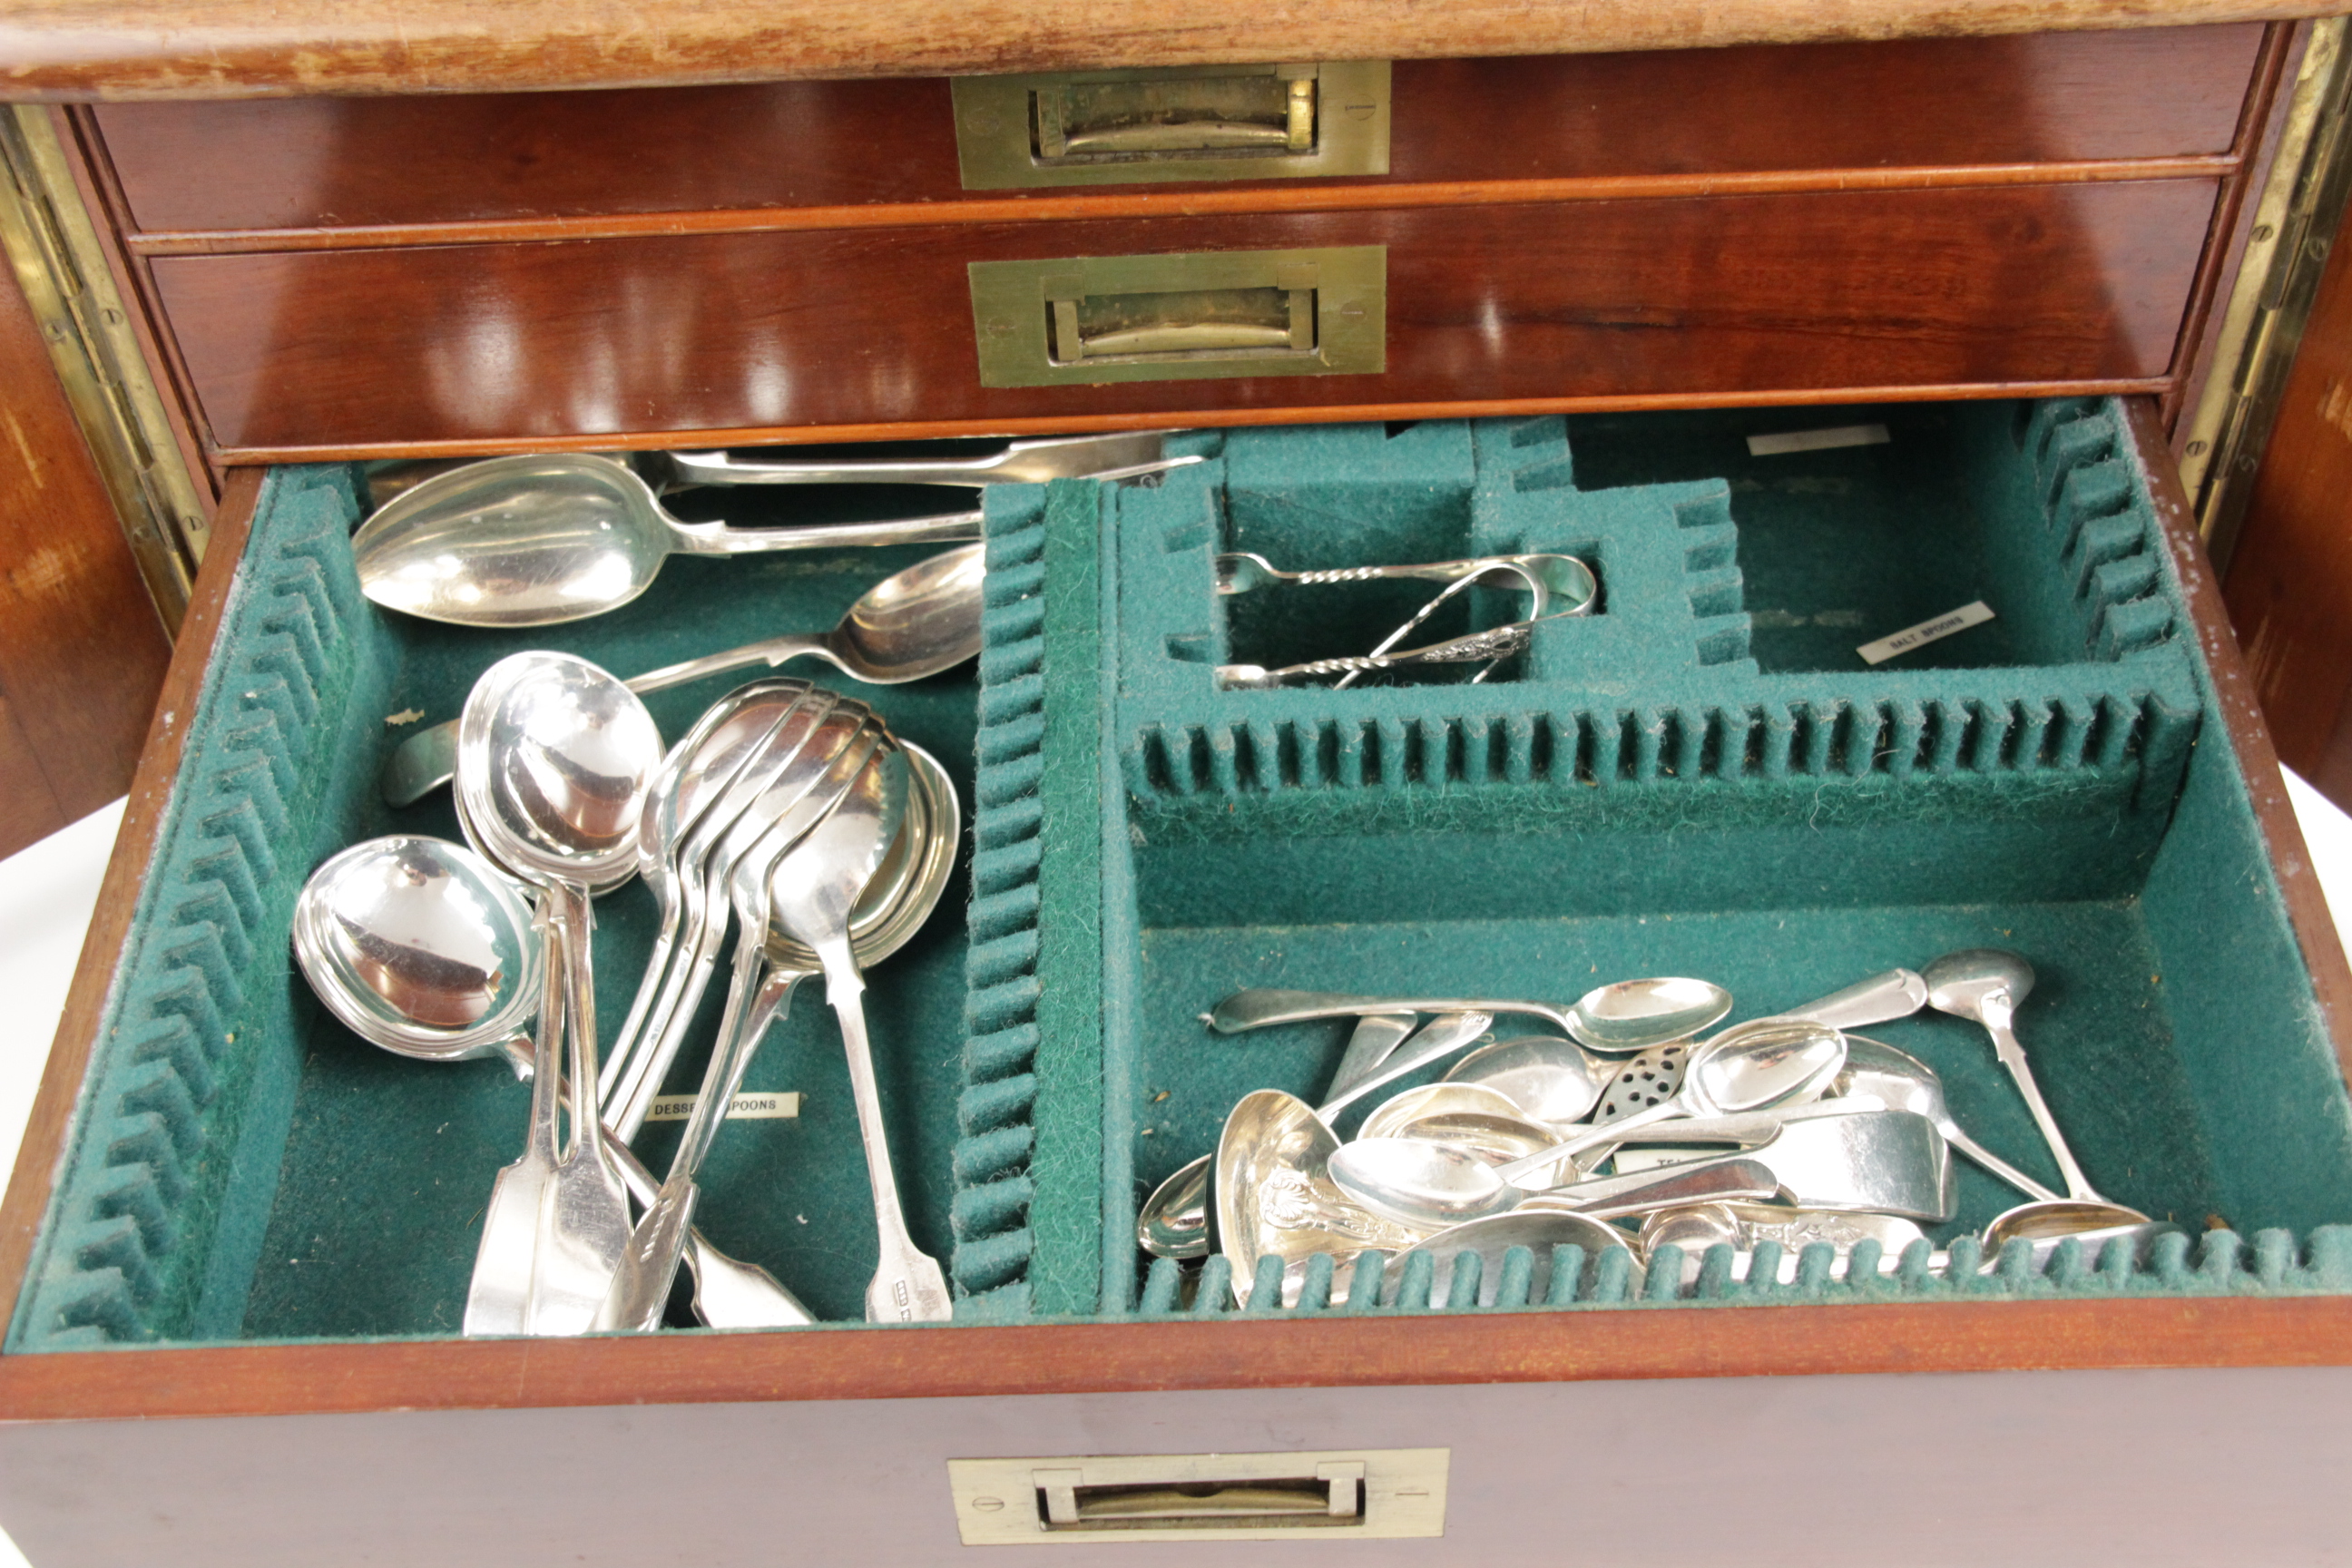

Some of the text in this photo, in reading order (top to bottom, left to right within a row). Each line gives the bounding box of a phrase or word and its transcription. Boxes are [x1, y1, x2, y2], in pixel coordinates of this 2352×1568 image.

[1889, 616, 1965, 650] SALT SPOONS
[655, 1103, 696, 1115] DESSE
